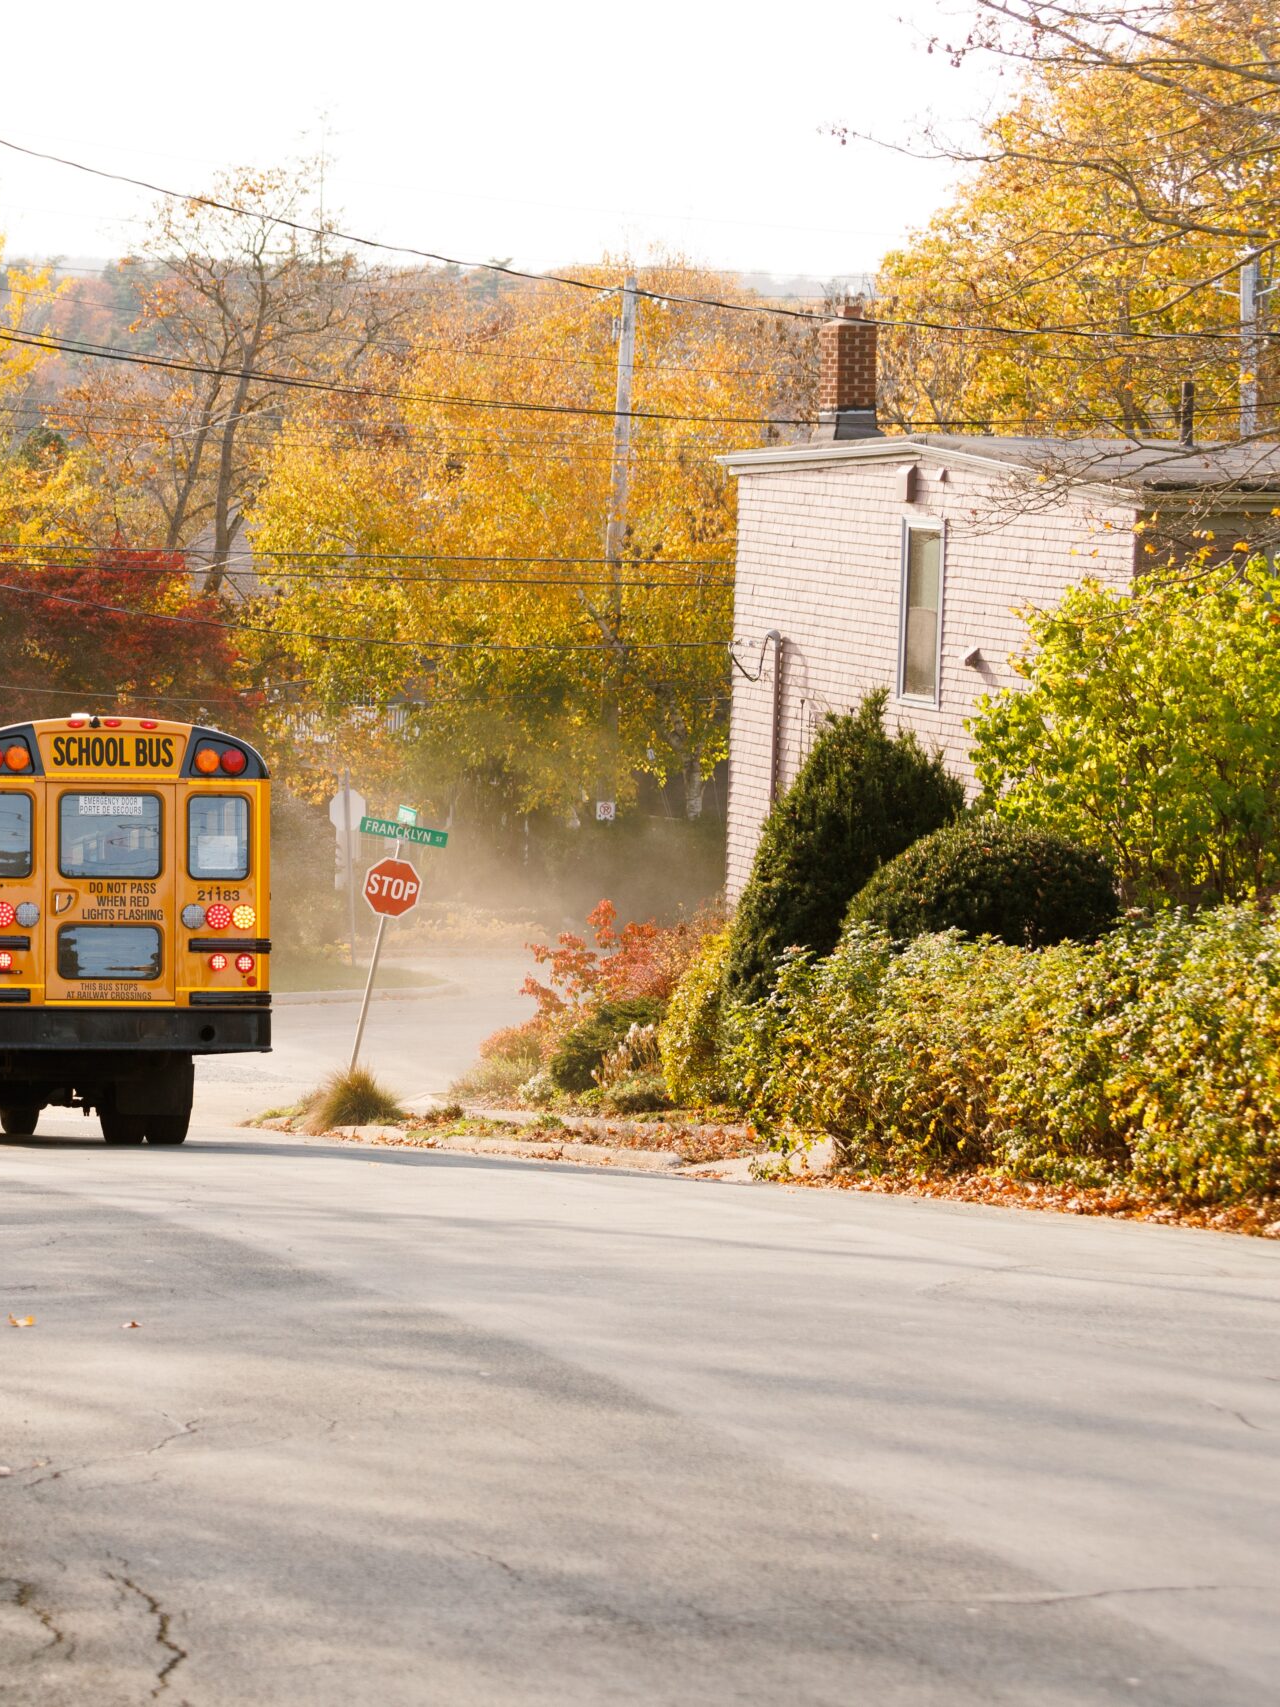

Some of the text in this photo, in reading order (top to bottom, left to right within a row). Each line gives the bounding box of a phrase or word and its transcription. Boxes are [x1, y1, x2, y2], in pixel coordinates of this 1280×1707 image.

[53, 736, 173, 767] SCHOOL BUS
[84, 796, 138, 806] EMERGENCY DOOR
[79, 805, 142, 815] PORTE DE SECOURS
[365, 820, 432, 842] FRANCKLYN
[89, 882, 157, 894] DO NOT PASS
[367, 873, 417, 901] STOP
[97, 896, 150, 907] WHEN RED
[197, 890, 240, 902] 21183
[82, 909, 164, 921] LIGHTS FLASHING
[80, 983, 138, 991] THIS BUS STOPS
[66, 991, 152, 1000] AT RAILWAY CROSSINGS
